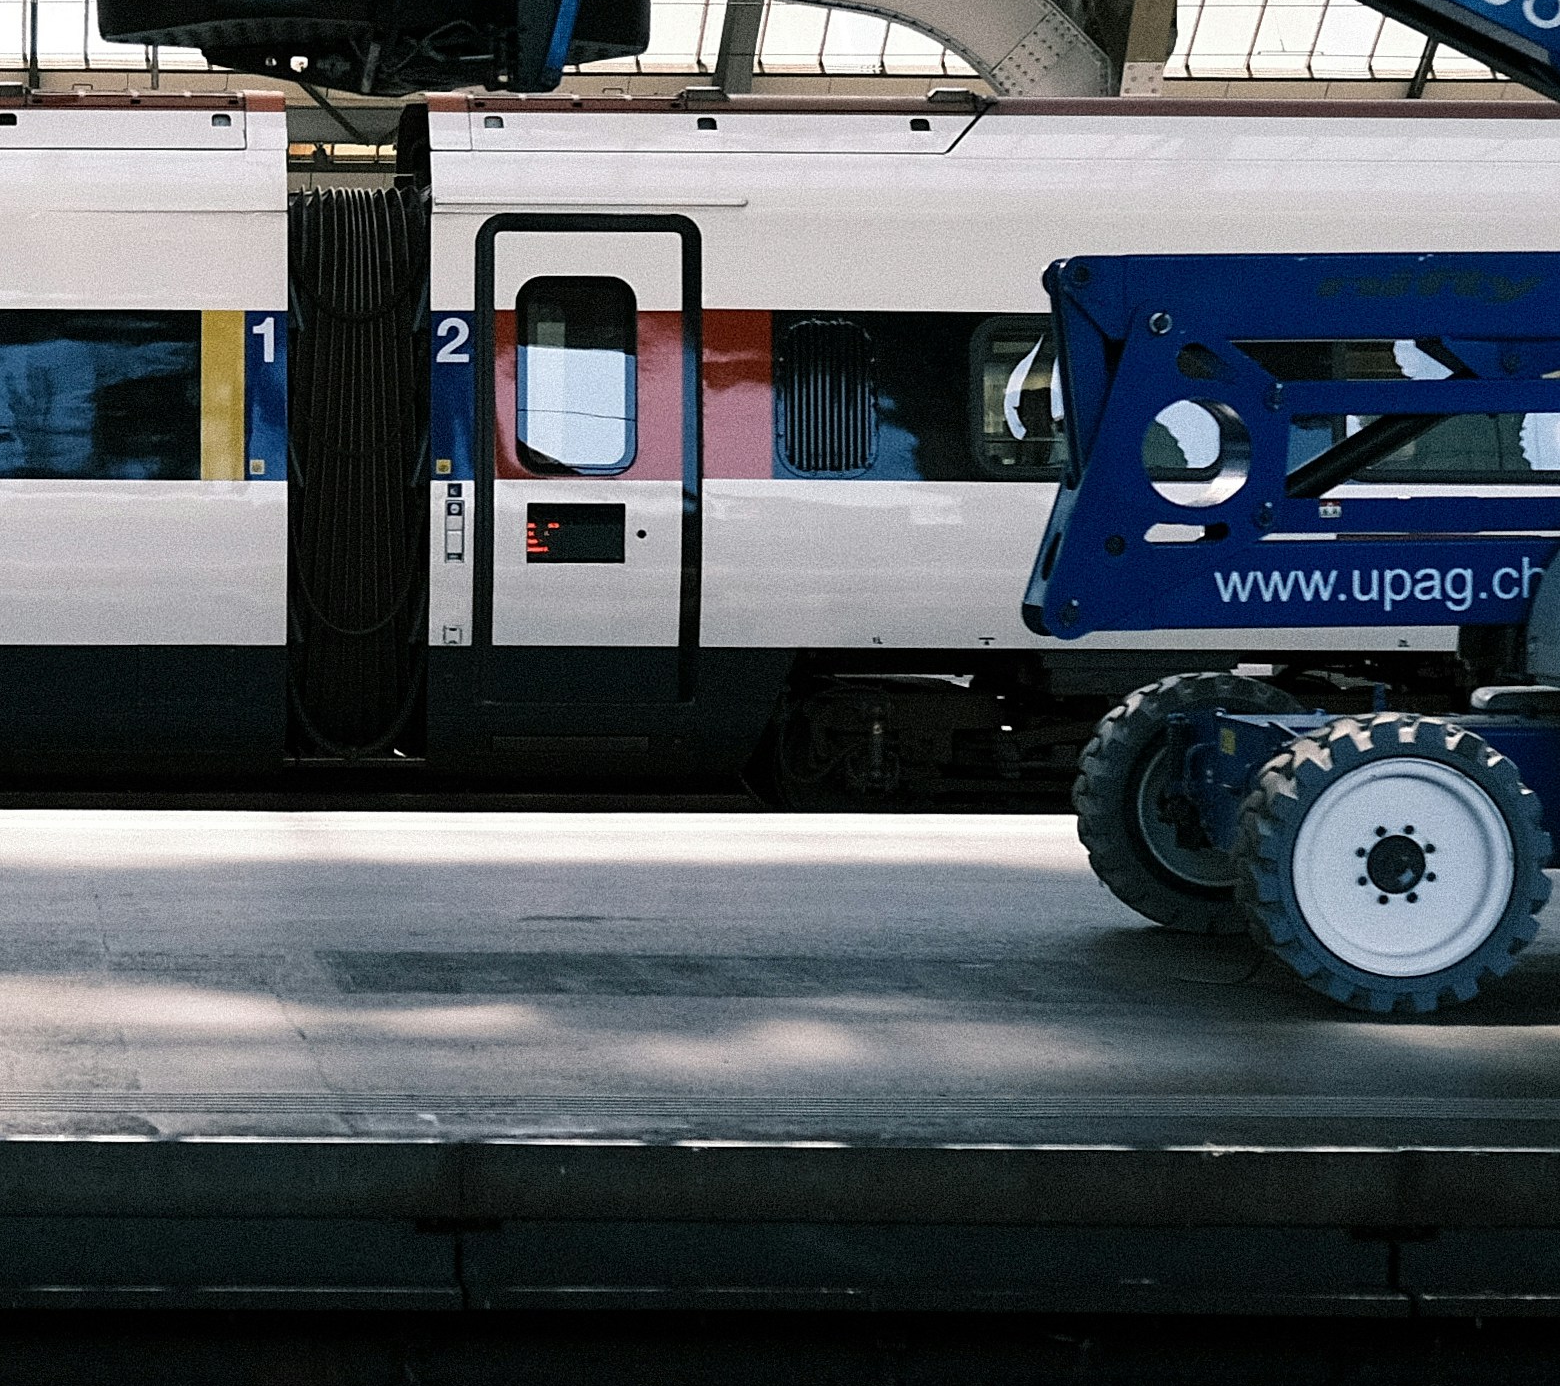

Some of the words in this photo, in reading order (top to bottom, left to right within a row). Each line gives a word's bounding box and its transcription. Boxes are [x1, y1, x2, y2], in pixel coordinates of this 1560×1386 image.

[251, 316, 276, 364] 1
[435, 316, 471, 364] 2
[1213, 555, 1547, 612] www.upag.ch
